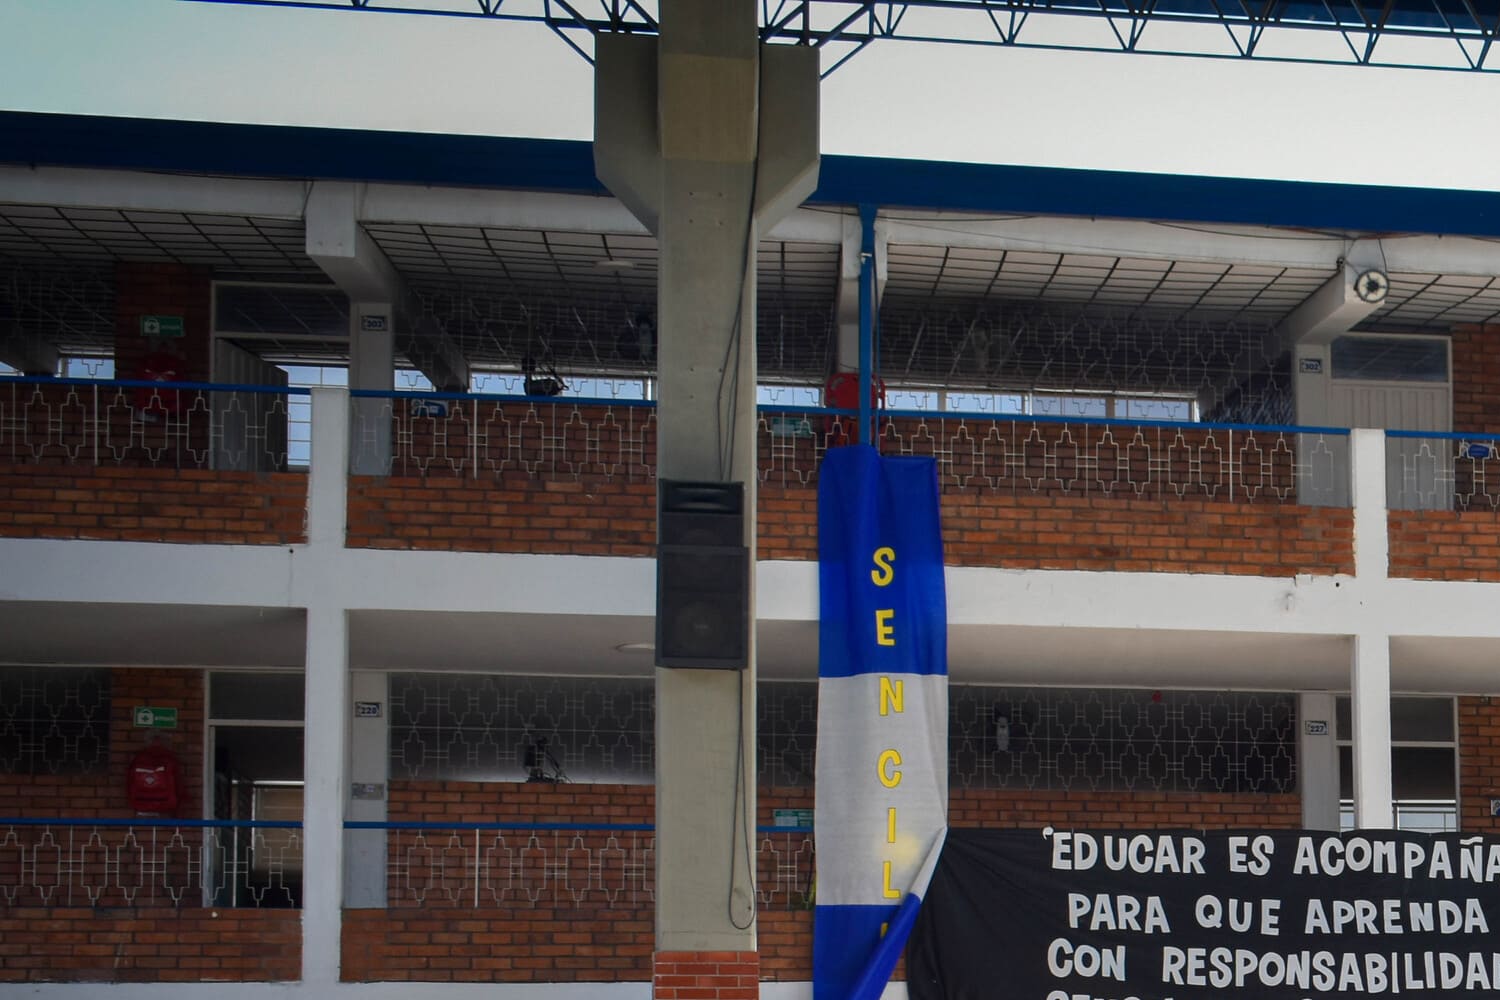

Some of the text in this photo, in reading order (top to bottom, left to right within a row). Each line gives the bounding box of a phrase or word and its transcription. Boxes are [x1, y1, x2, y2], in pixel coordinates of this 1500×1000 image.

[1229, 835, 1275, 876] ES
[1068, 893, 1171, 935] PARA
[1195, 894, 1281, 936] QUE
[1304, 897, 1489, 935] APRENDA
[1047, 937, 1127, 982] CON
